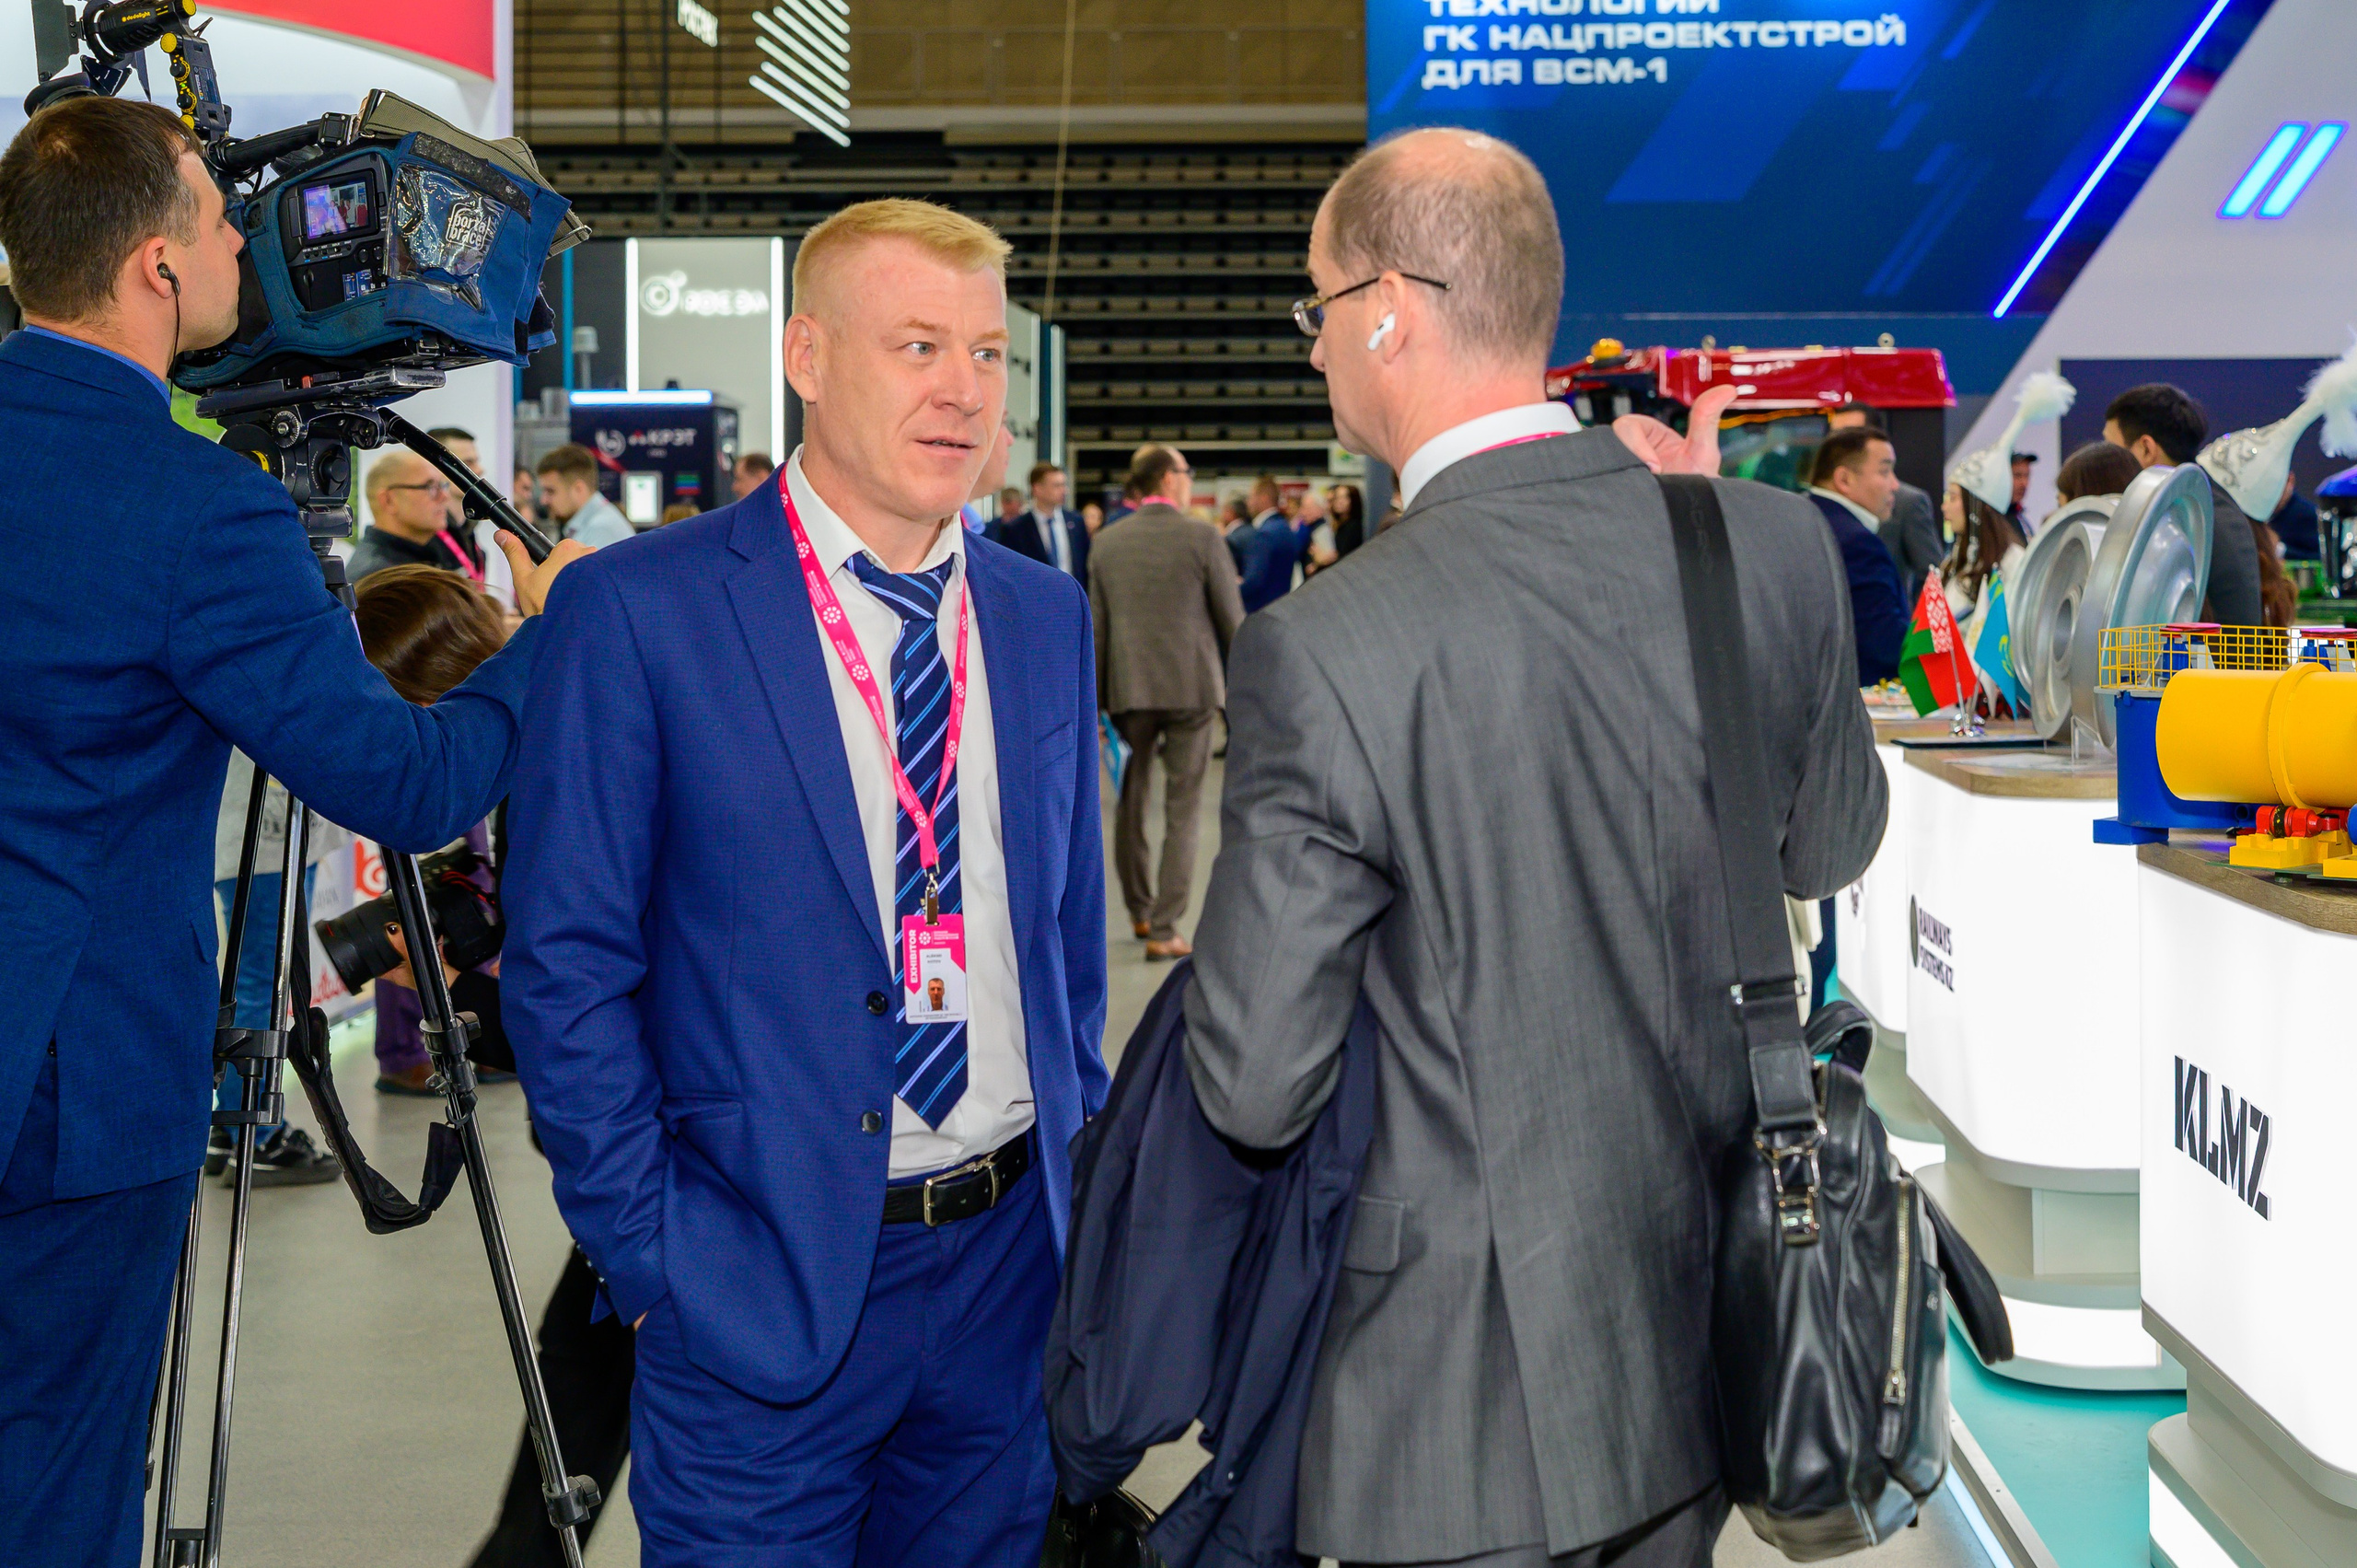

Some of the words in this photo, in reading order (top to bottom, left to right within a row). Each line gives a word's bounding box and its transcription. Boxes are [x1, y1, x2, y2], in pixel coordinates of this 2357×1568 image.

[1423, 25, 1479, 52] ГК
[1488, 13, 1907, 53] НАЦПРОЕКТСТРОЙ
[1422, 58, 1523, 90] ДЛЯ
[1532, 56, 1668, 85] ВСМ-1
[449, 225, 483, 246] brace
[454, 215, 487, 235] porta
[909, 929, 919, 984] EXHIBITOR
[2175, 1055, 2272, 1221] KLMZ
